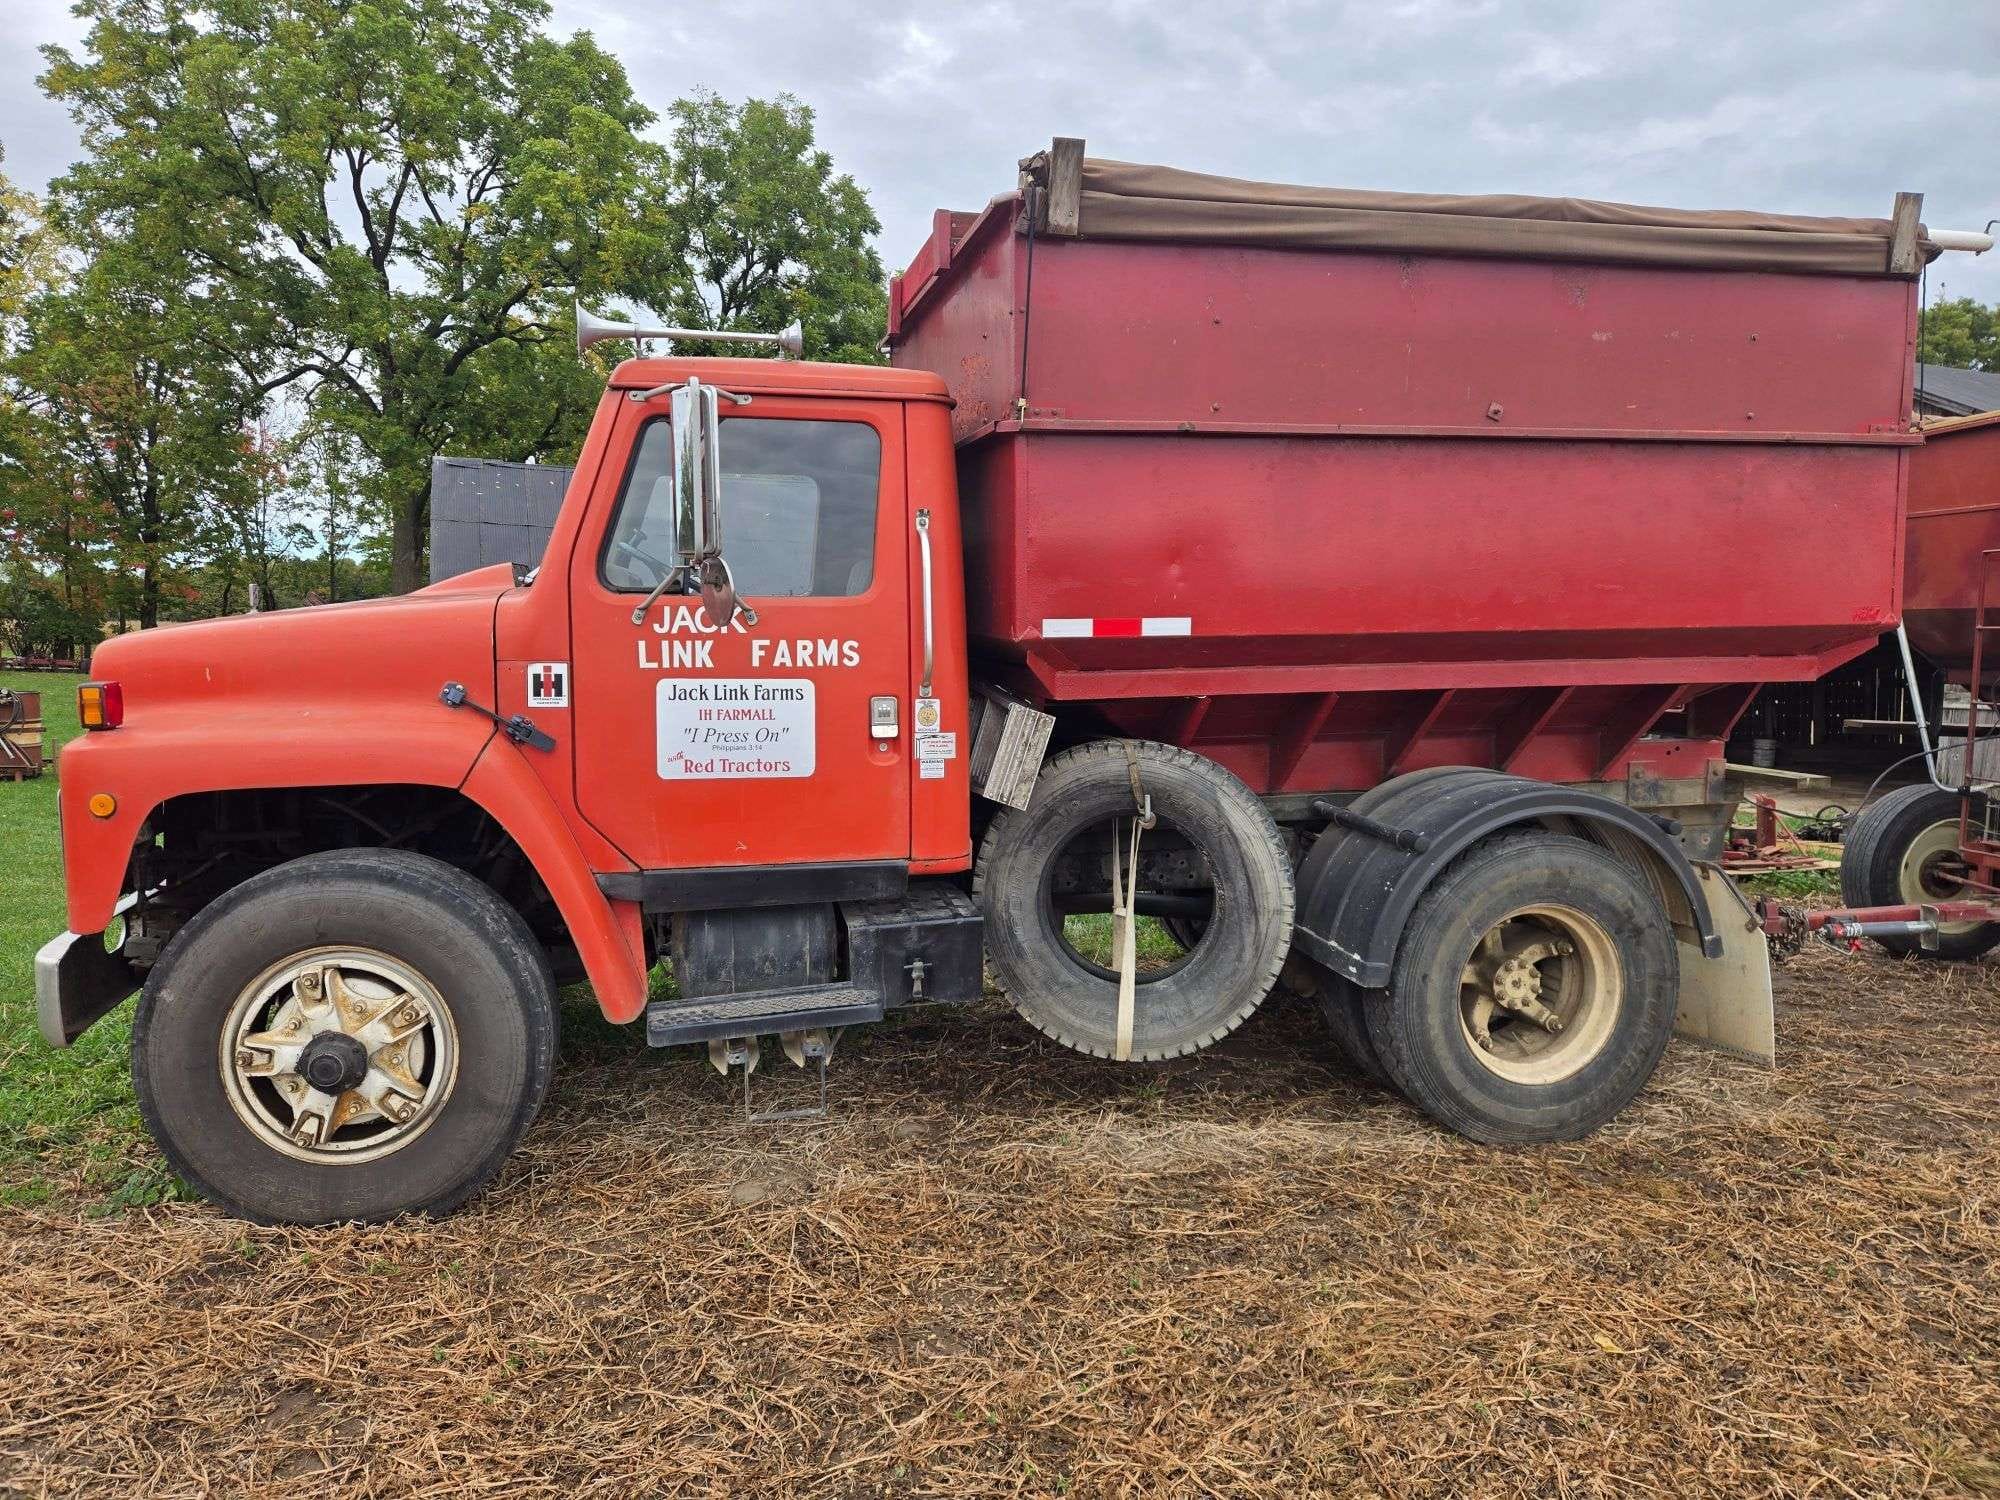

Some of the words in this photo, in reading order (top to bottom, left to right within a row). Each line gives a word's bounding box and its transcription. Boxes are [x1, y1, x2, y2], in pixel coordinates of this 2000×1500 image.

[653, 605, 748, 634] JACK
[637, 639, 714, 669] LINK
[751, 638, 860, 668] FARMS
[668, 684, 709, 701] Jack
[714, 684, 750, 701] Link
[754, 684, 804, 701] Farms
[699, 709, 712, 721] IH
[717, 709, 776, 721] FARMALL
[684, 727, 701, 743] "I
[703, 727, 749, 743] Press
[755, 727, 790, 743] On"
[667, 750, 685, 763] with
[684, 759, 714, 773] Red
[719, 758, 791, 773] Tractors
